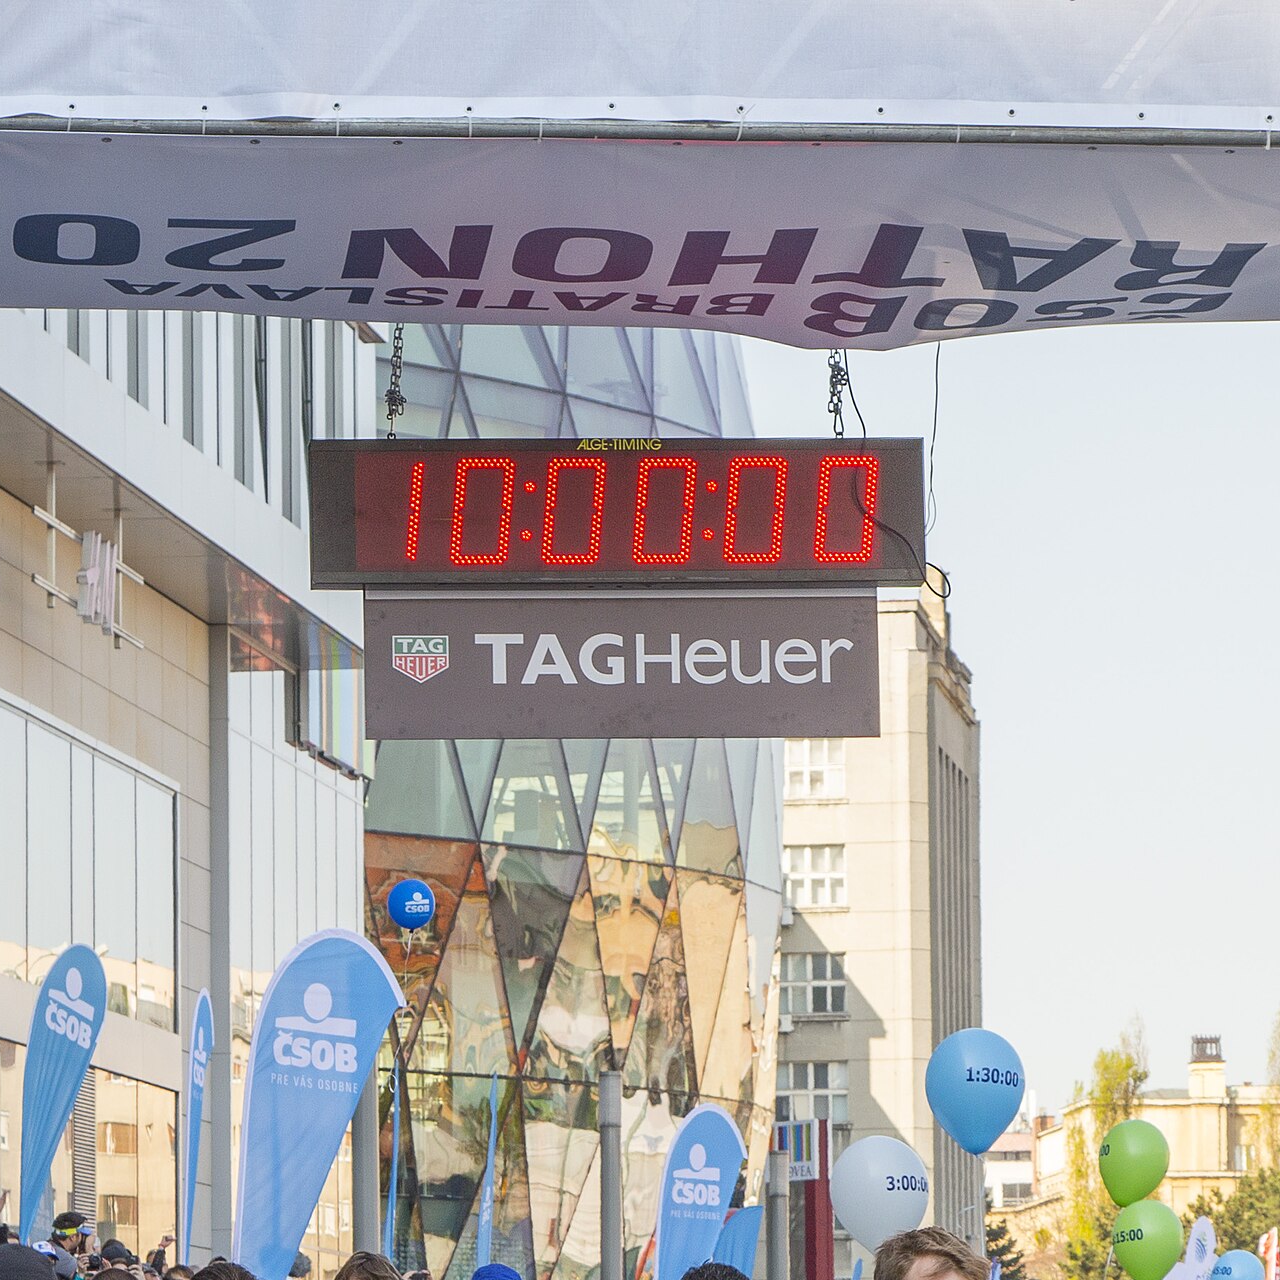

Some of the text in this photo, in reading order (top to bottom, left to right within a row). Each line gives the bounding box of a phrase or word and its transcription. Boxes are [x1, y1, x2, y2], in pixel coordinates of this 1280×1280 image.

[103, 278, 1233, 337] ČSOB BRATISLAVA
[577, 438, 661, 451] ALGE-TIMING
[405, 455, 879, 565] 10:00:00
[395, 638, 444, 653] TAG
[393, 656, 449, 682] HEUER
[45, 1000, 92, 1049] ČSOB
[273, 1030, 358, 1073] ČSOB
[271, 1073, 358, 1094] PRE VÁS OSOBNE
[966, 1067, 1019, 1087] 1:30:00
[672, 1179, 720, 1206] ČSOB
